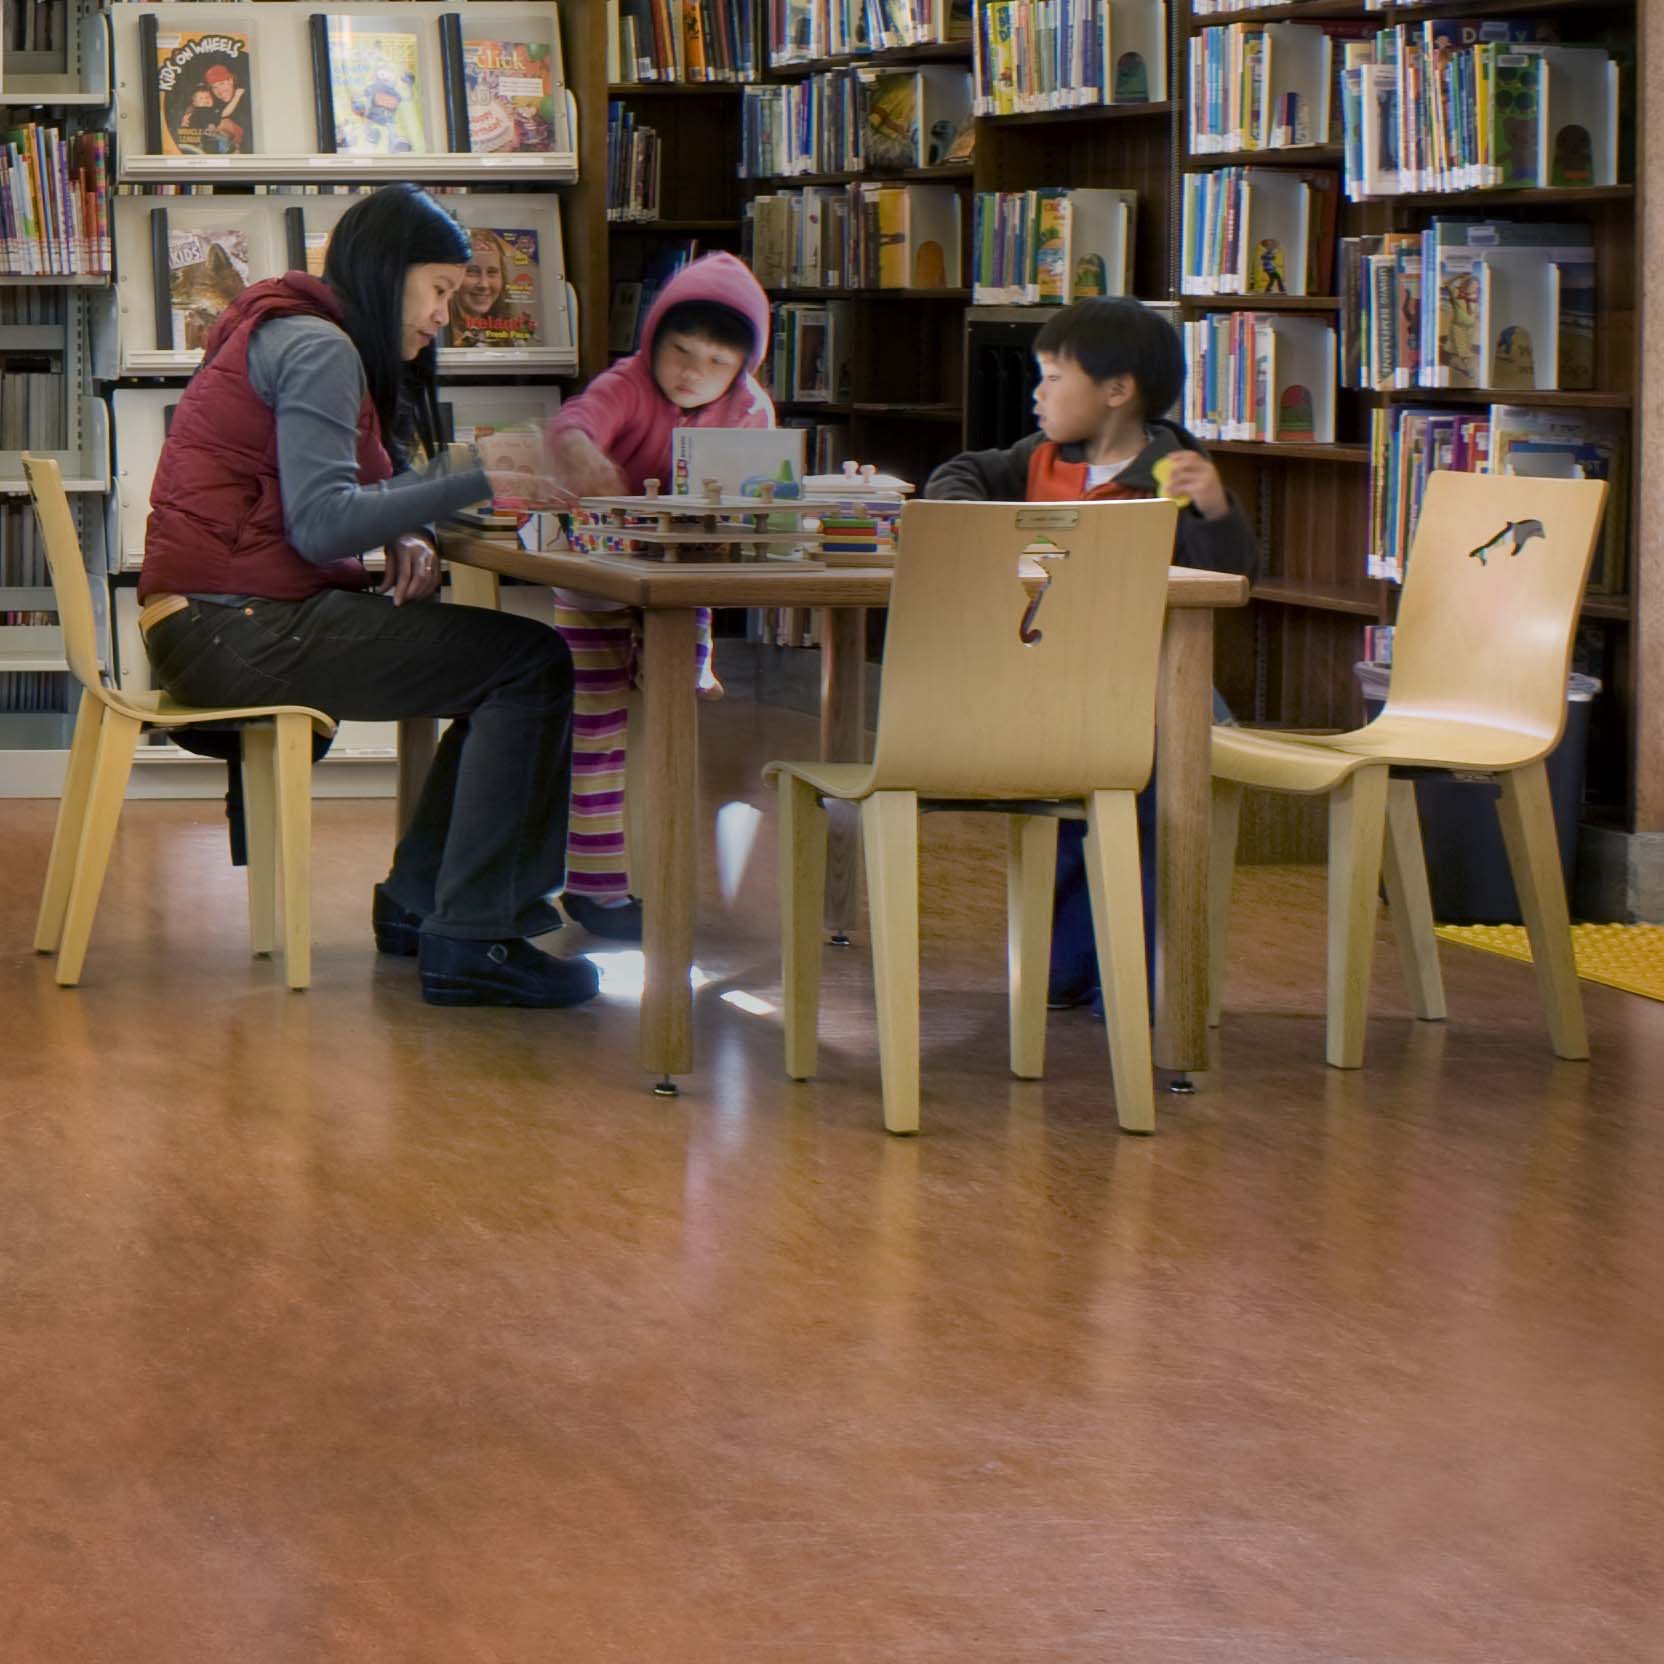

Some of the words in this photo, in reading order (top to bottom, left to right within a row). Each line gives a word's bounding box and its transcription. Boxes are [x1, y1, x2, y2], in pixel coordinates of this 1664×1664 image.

[176, 46, 194, 65] ON
[190, 36, 243, 58] WHEELS
[464, 313, 538, 333] Ireland's
